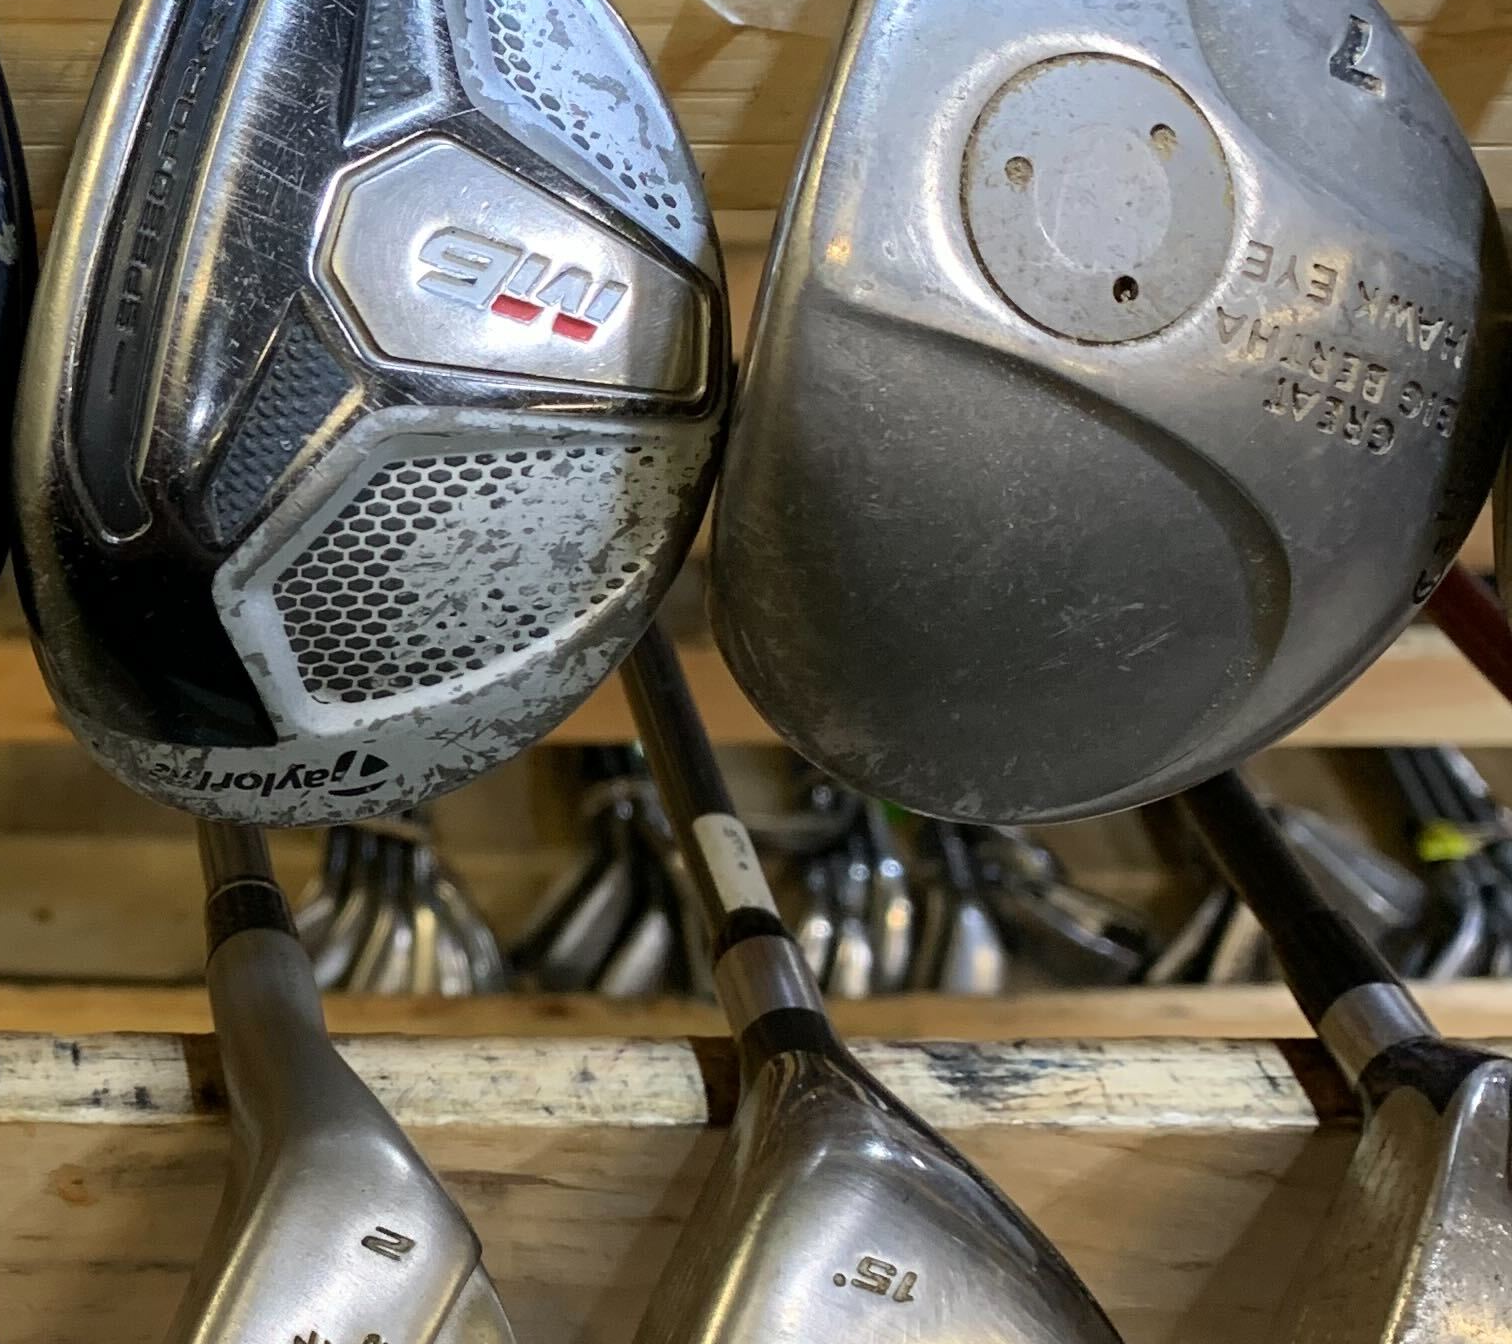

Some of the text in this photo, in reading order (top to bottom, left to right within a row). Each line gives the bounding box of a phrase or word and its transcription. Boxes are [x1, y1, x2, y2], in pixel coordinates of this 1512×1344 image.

[1329, 14, 1387, 97] 7
[1241, 240, 1467, 369] HAWK EYE
[1216, 307, 1457, 438] BIG BERTHA
[1262, 377, 1395, 456] GREAT
[148, 750, 389, 797] Taylore
